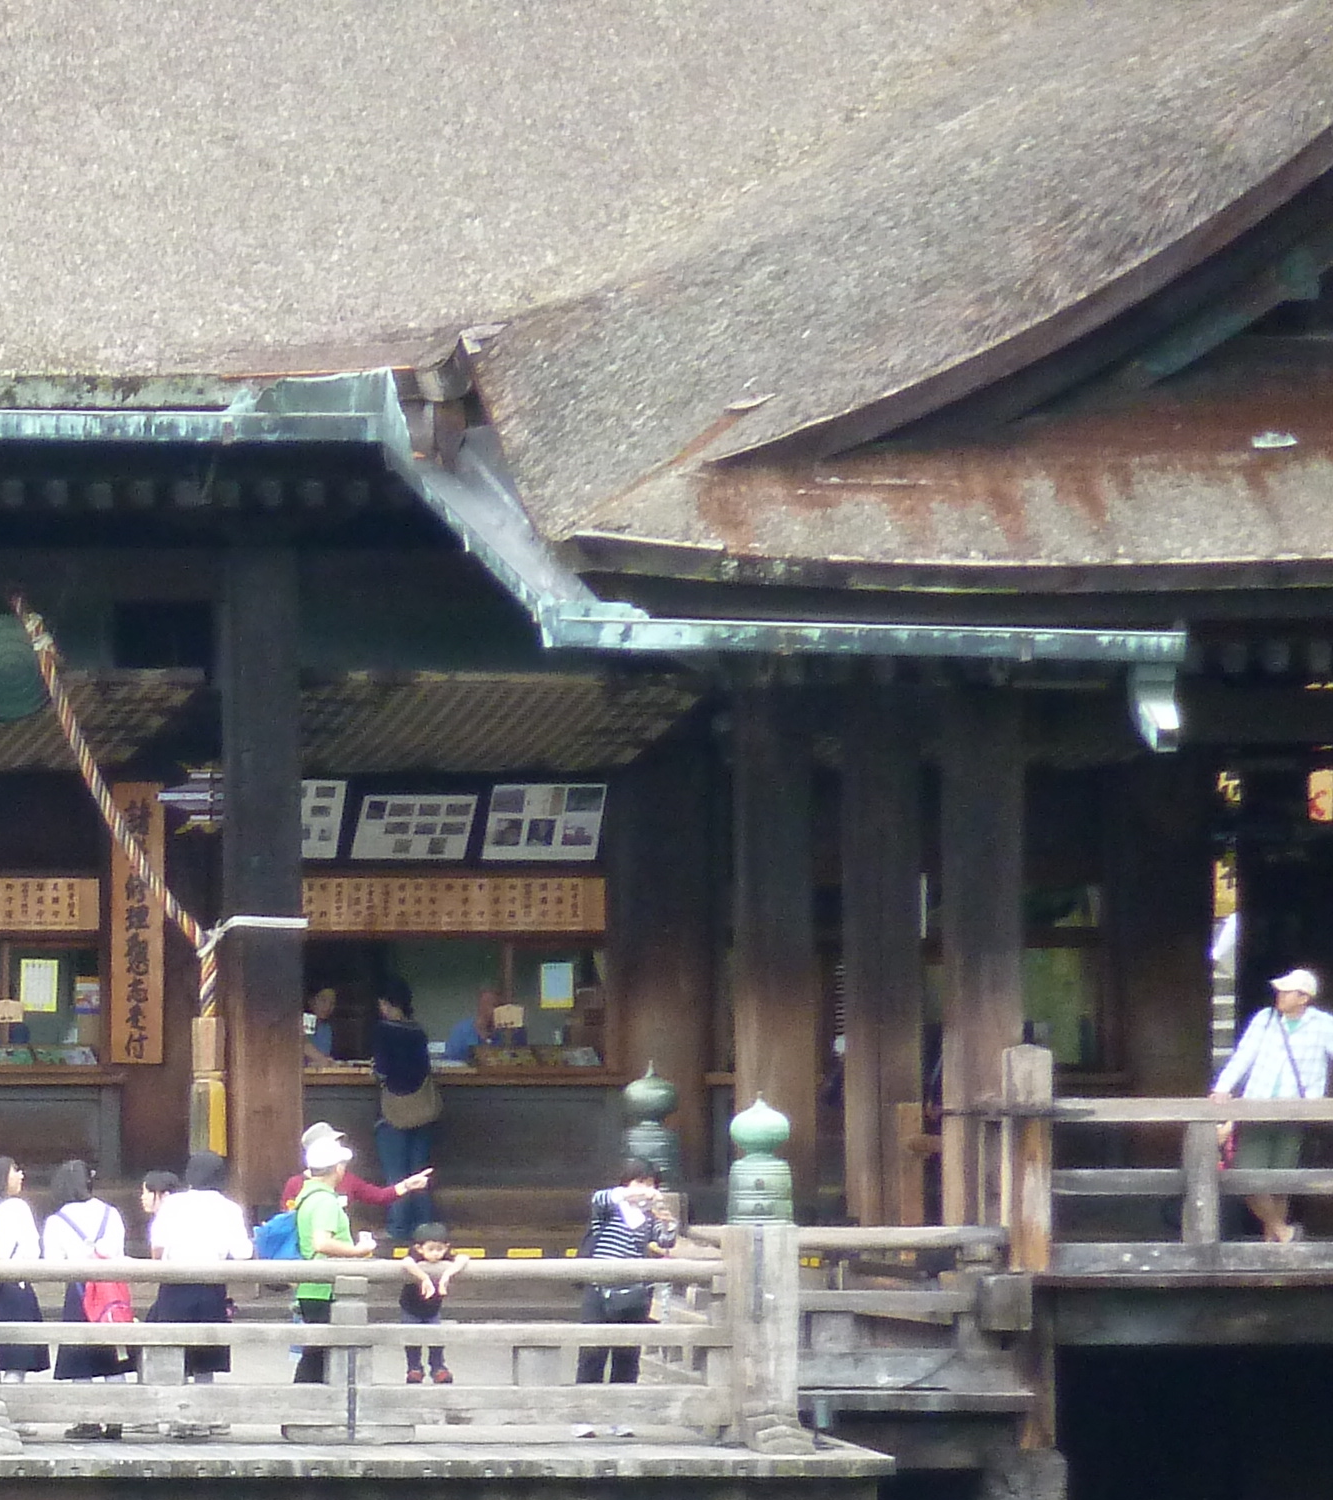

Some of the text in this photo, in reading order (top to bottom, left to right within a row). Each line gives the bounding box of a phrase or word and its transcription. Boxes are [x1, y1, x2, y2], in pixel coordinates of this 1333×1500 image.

[124, 798, 151, 1060] 諸修理懇志受付
